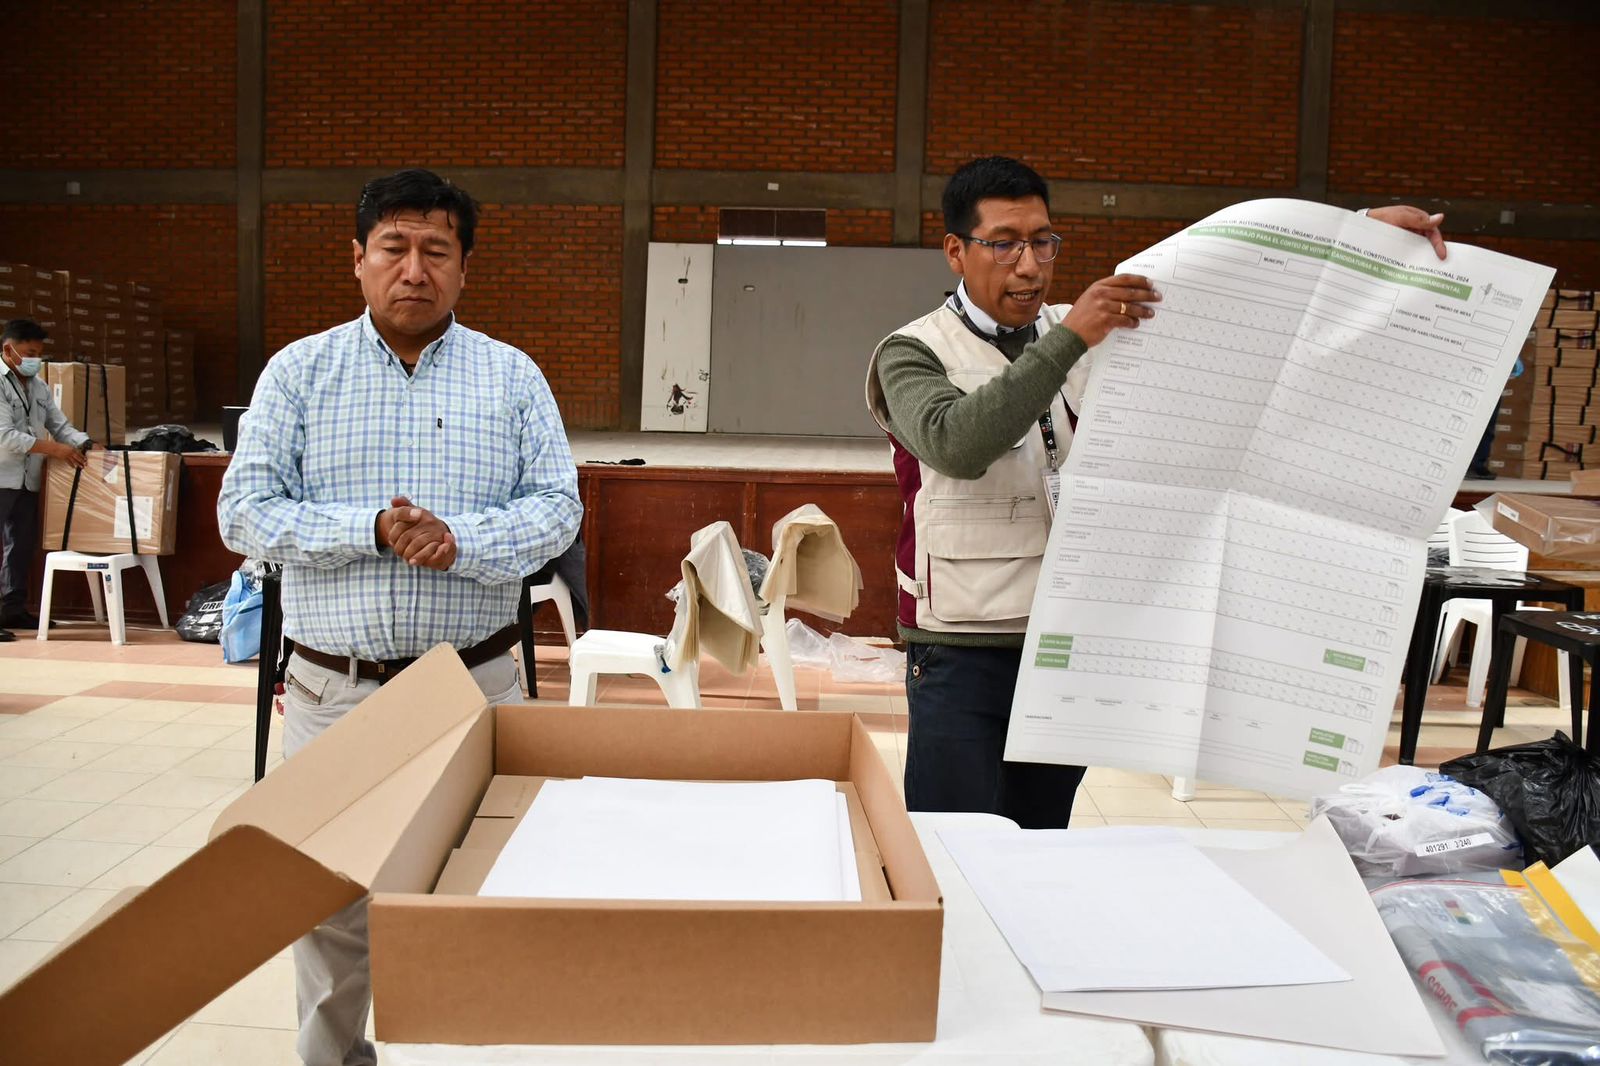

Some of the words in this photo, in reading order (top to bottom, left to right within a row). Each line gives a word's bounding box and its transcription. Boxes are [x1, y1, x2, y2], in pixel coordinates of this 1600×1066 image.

[1227, 228, 1256, 239] TRABAJO
[1256, 233, 1272, 243] PARA
[1363, 249, 1407, 270] CONSTITUCIONAL
[1408, 263, 1455, 280] PLURINACIONAL
[1425, 842, 1449, 853] 401291
